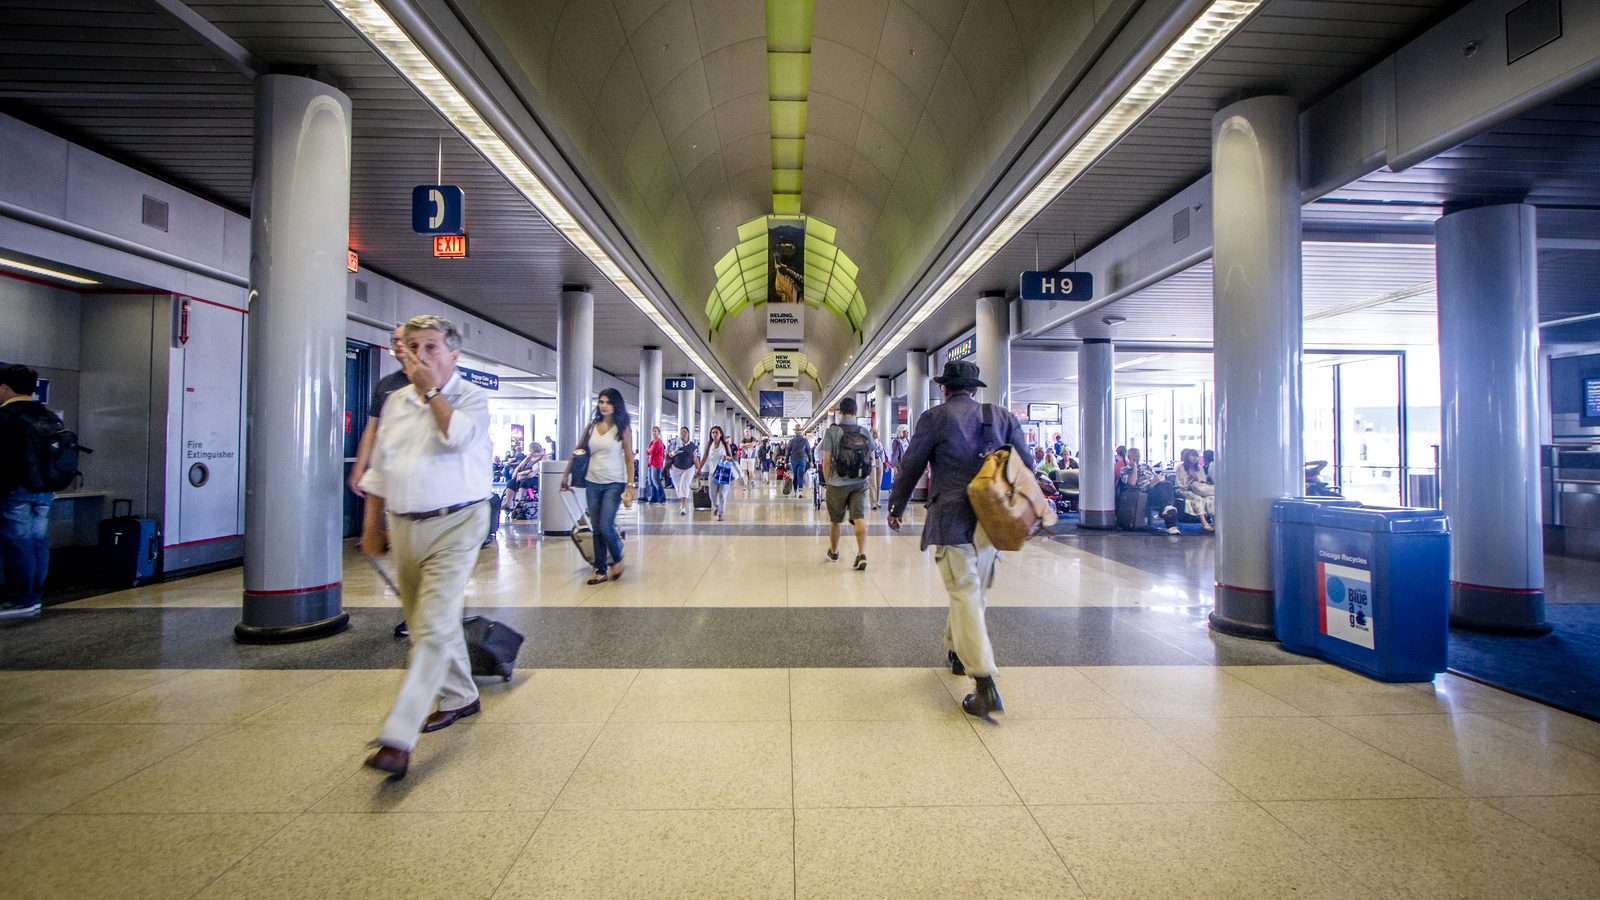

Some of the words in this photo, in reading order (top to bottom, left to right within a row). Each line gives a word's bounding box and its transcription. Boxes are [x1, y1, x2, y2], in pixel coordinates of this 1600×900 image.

[437, 237, 464, 252] EXIT
[1042, 278, 1055, 294] H
[1061, 278, 1073, 294] 9
[188, 441, 203, 449] Fire
[188, 451, 234, 460] Extinguisher
[1319, 550, 1341, 560] Chicago
[1341, 554, 1368, 564] Recycles
[1348, 588, 1368, 606] Blue
